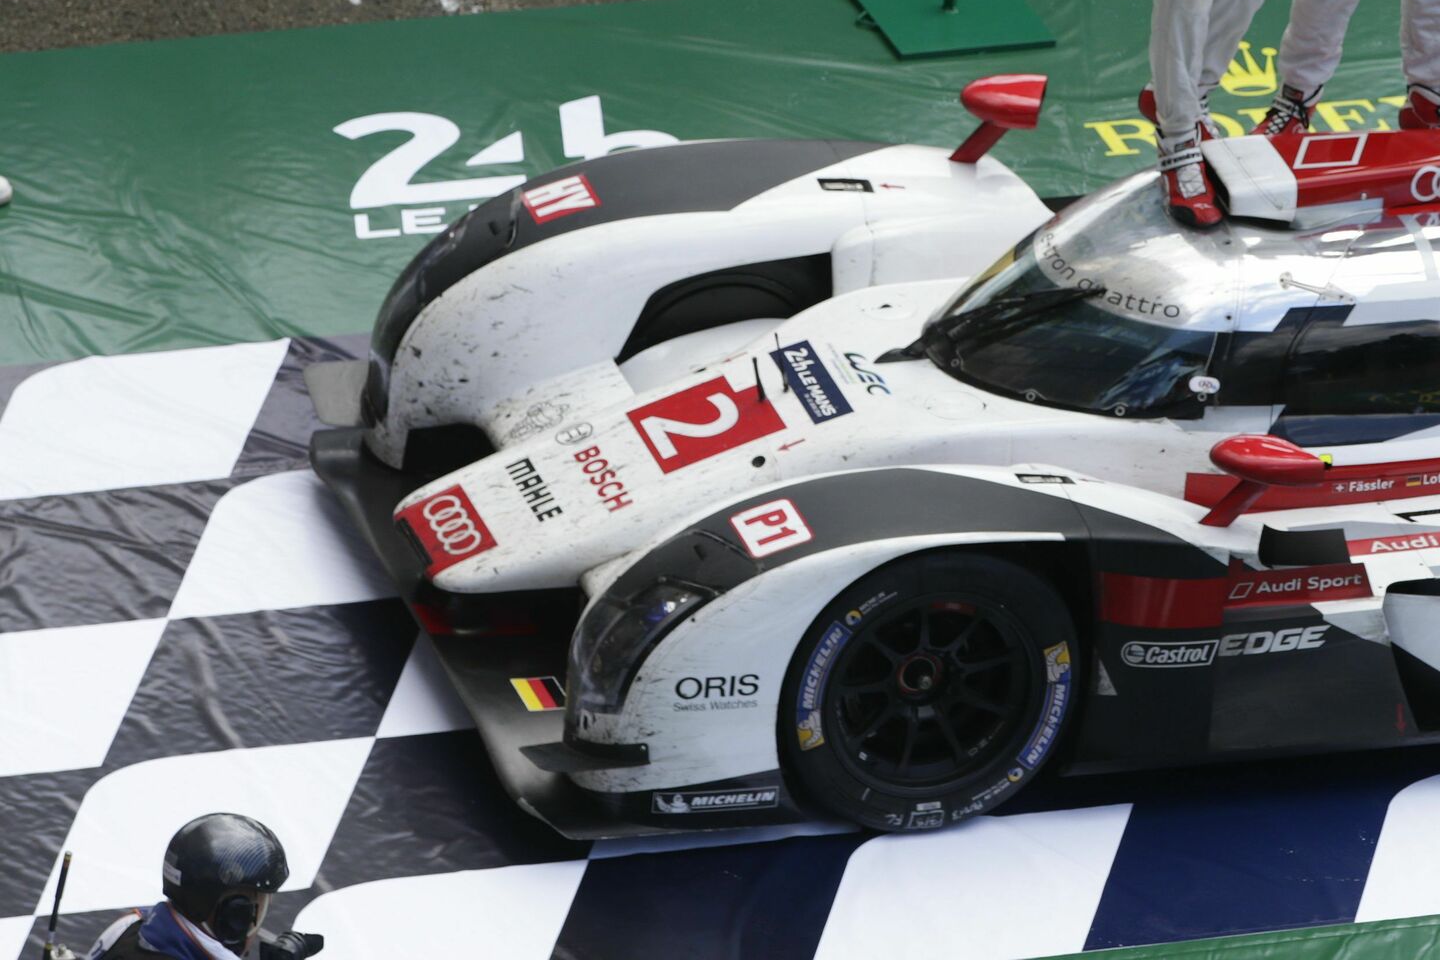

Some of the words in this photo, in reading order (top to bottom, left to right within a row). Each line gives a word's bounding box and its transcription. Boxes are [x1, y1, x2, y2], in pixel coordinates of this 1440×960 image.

[524, 176, 596, 217] HY
[354, 207, 448, 240] LE
[1077, 277, 1181, 319] qattro
[798, 371, 818, 386] LE
[806, 384, 838, 417] MANS
[640, 392, 740, 461] 2
[504, 457, 563, 522] MAHLE
[574, 445, 634, 513] BOSCH
[1348, 478, 1395, 493] Fässler
[744, 508, 798, 547] P1
[1371, 535, 1440, 555] Audi
[1256, 578, 1302, 595] Audi
[1306, 573, 1362, 593] Sport
[1145, 643, 1210, 664] Castrol
[1218, 625, 1332, 658] EDGE
[801, 627, 843, 710] MICHELIN
[675, 674, 760, 700] ORIS
[673, 702, 706, 713] Swiss
[709, 699, 758, 712] Watches
[1026, 682, 1067, 766] MICHELIN
[690, 791, 776, 807] MICHELIN
